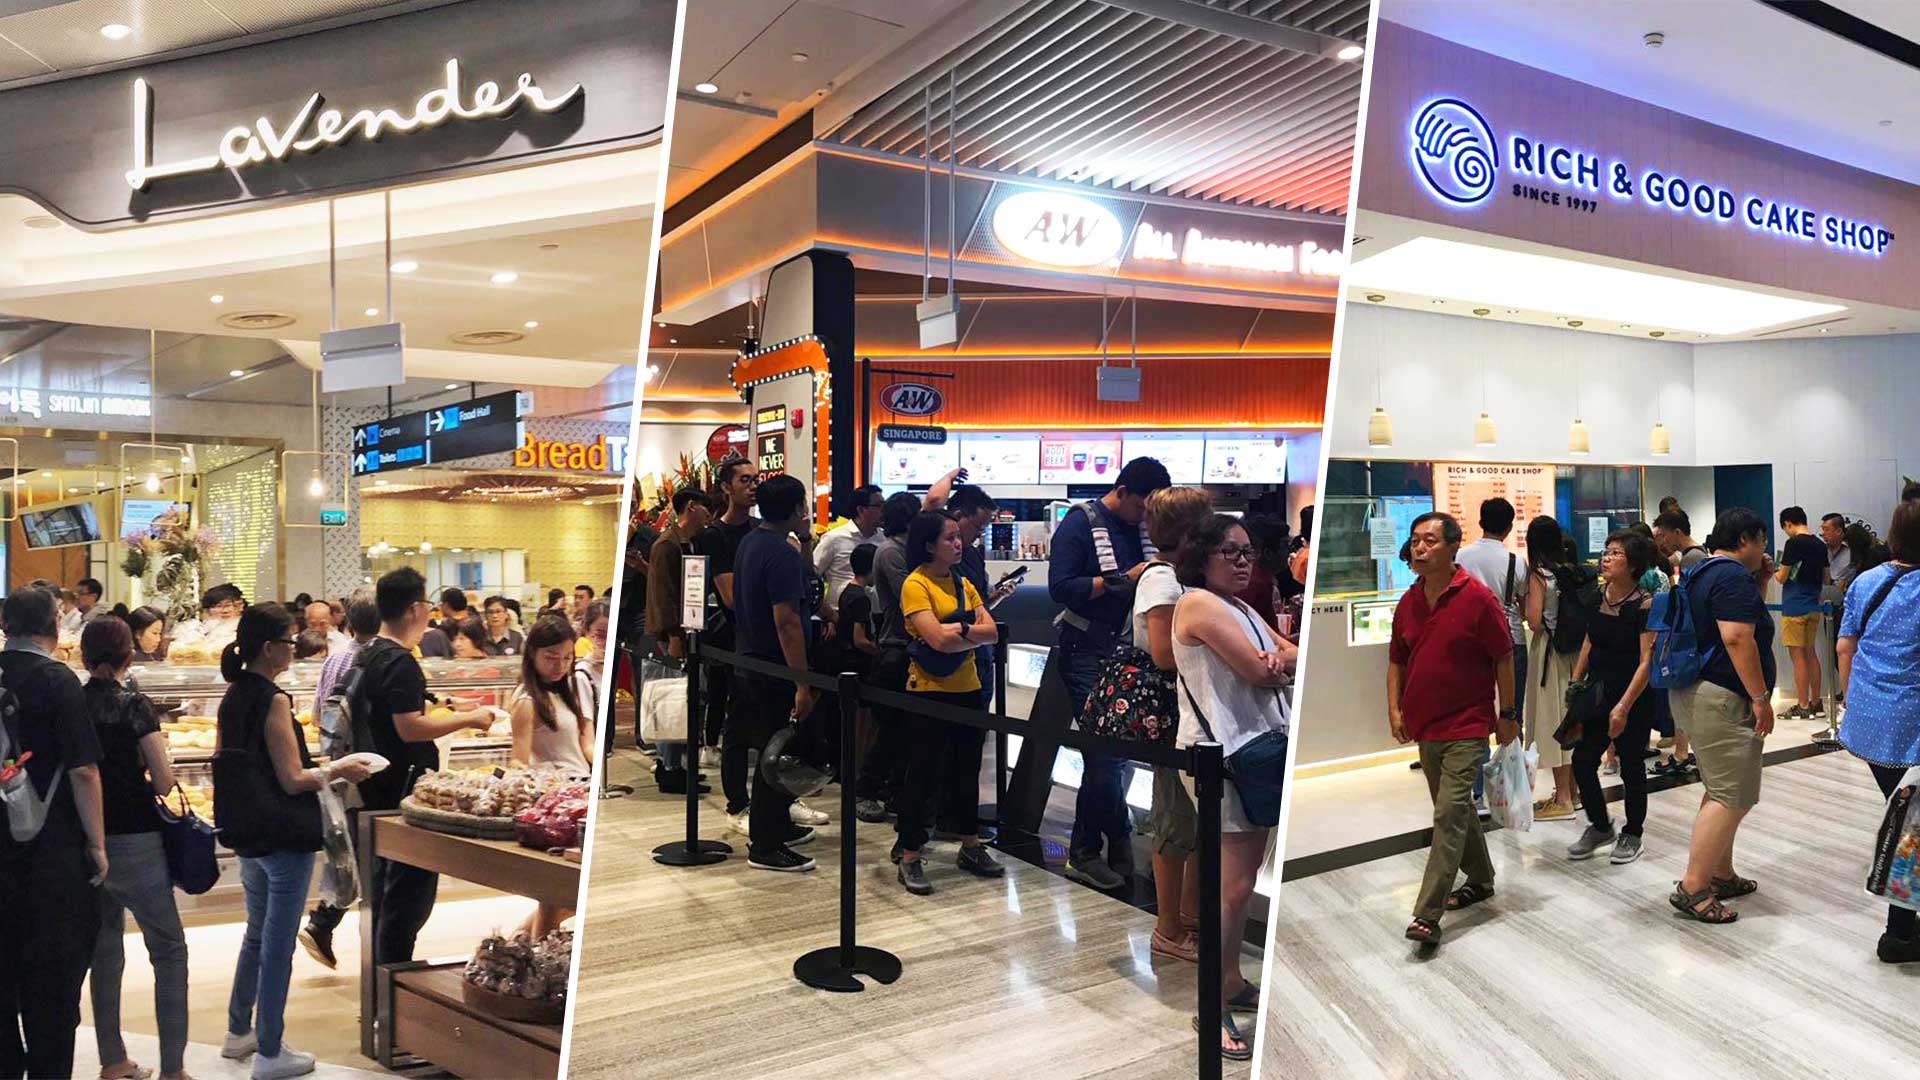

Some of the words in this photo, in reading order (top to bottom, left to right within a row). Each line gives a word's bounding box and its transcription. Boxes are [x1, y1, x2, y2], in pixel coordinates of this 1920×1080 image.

[125, 58, 581, 190] Lavender
[1512, 136, 1600, 188] RICH
[1614, 162, 1633, 197] &
[1645, 171, 1736, 219] GOOD
[1747, 198, 1817, 239] CAKE
[1512, 183, 1561, 206] SINCE
[1566, 195, 1598, 214] 1997
[459, 408, 477, 422] Food
[477, 405, 491, 418] Hall
[883, 428, 942, 441] SINGAPORE
[765, 437, 777, 453] WE
[759, 453, 785, 471] NEVER
[1447, 466, 1467, 474] RICH
[1476, 467, 1499, 475] GOOD
[1501, 467, 1520, 475] CAKE
[1324, 605, 1345, 614] HERE
